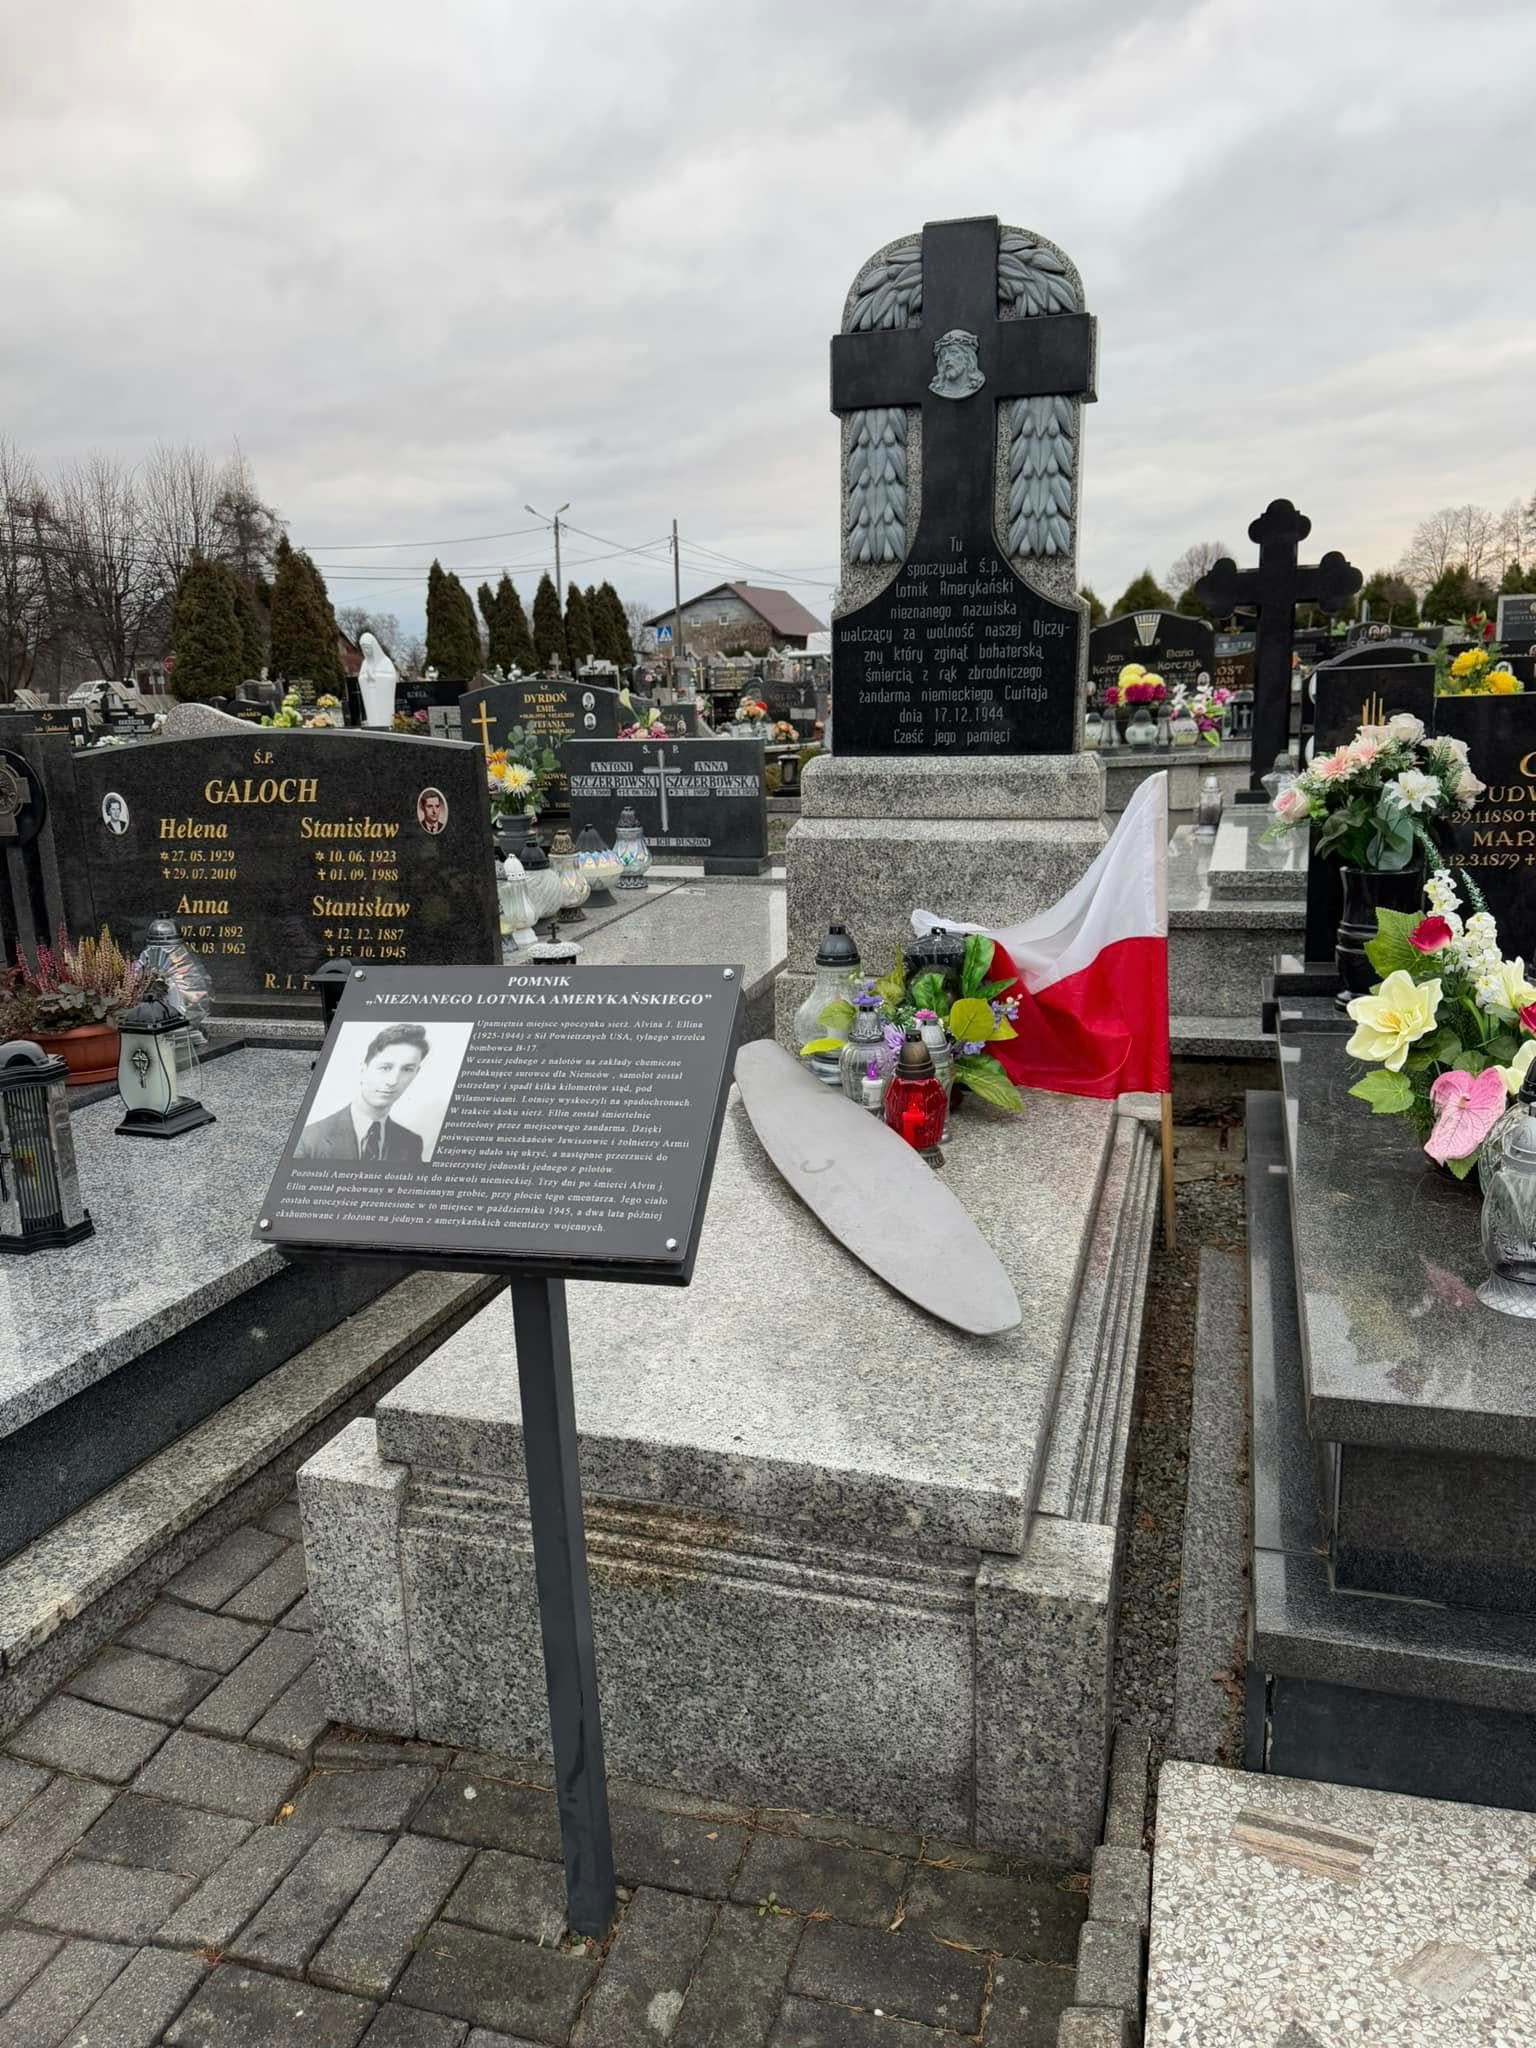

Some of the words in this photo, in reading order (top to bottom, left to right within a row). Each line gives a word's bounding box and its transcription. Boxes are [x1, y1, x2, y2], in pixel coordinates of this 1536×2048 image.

[950, 536, 962, 552] Tu
[907, 558, 967, 579] spoczywał
[896, 581, 928, 598] Lotnik
[940, 577, 1013, 598] Amerykański
[890, 605, 951, 620] nieznanego
[962, 599, 1016, 616] nazwiska
[840, 626, 892, 643] walczący
[903, 628, 915, 640] za
[926, 622, 974, 639] wolność
[985, 621, 1021, 639] naszej
[1033, 620, 1070, 637] Ojczy-
[864, 650, 883, 664] zny
[894, 646, 923, 663] który
[934, 644, 968, 663] zginął
[979, 642, 1044, 659] bohaterską
[865, 667, 914, 684] śmiercią
[922, 670, 928, 681] z
[939, 665, 957, 682] rąk
[968, 663, 1042, 681] zbrodniczego
[523, 691, 568, 704] DYRDOŃ
[859, 688, 910, 703] żandarma
[921, 686, 993, 704] niemieckiego
[1004, 685, 1048, 702] Cwitaja
[899, 708, 922, 723] dnia
[935, 706, 1003, 722] 17.12.1944
[894, 728, 924, 743] Cześć
[933, 729, 956, 746] jego
[967, 727, 1010, 745] pamięci
[253, 748, 274, 764] Ś.P.
[592, 762, 633, 772] ANTONI
[696, 762, 728, 772] ANNA
[572, 776, 659, 788] SZCZERBOWSKI
[666, 776, 758, 788] SZCZERBOWSKA
[204, 778, 318, 804] GALOCH
[159, 818, 228, 838] Helena
[300, 816, 399, 838] Stanisław
[171, 850, 187, 862] 27.
[189, 850, 206, 862] 05.
[209, 850, 235, 862] 1929
[329, 850, 345, 862] 10.
[348, 850, 365, 862] 06.
[369, 850, 396, 862] 1923
[173, 867, 189, 879] 29.
[191, 868, 208, 880] 07.
[210, 868, 237, 880] 2010
[329, 868, 347, 880] 01.
[350, 868, 367, 880] 09.
[372, 868, 398, 881] 1988
[176, 893, 229, 914] Anna
[312, 895, 410, 917] Stanisław
[198, 925, 215, 937] 07.
[218, 925, 243, 938] 1892
[337, 927, 353, 940] 12.
[357, 928, 373, 940] 12.
[377, 928, 404, 940] 1887
[221, 942, 246, 954] 1962
[359, 945, 375, 958] 10.
[380, 945, 406, 958] 1945
[264, 972, 280, 989] R.
[286, 974, 297, 989] I.
[507, 976, 571, 986] POMNIK
[365, 994, 473, 1005] „NIEZNANEGO
[476, 994, 546, 1004] LOTNIKA
[549, 992, 712, 1004] AMERYKAŃSKIEGO”
